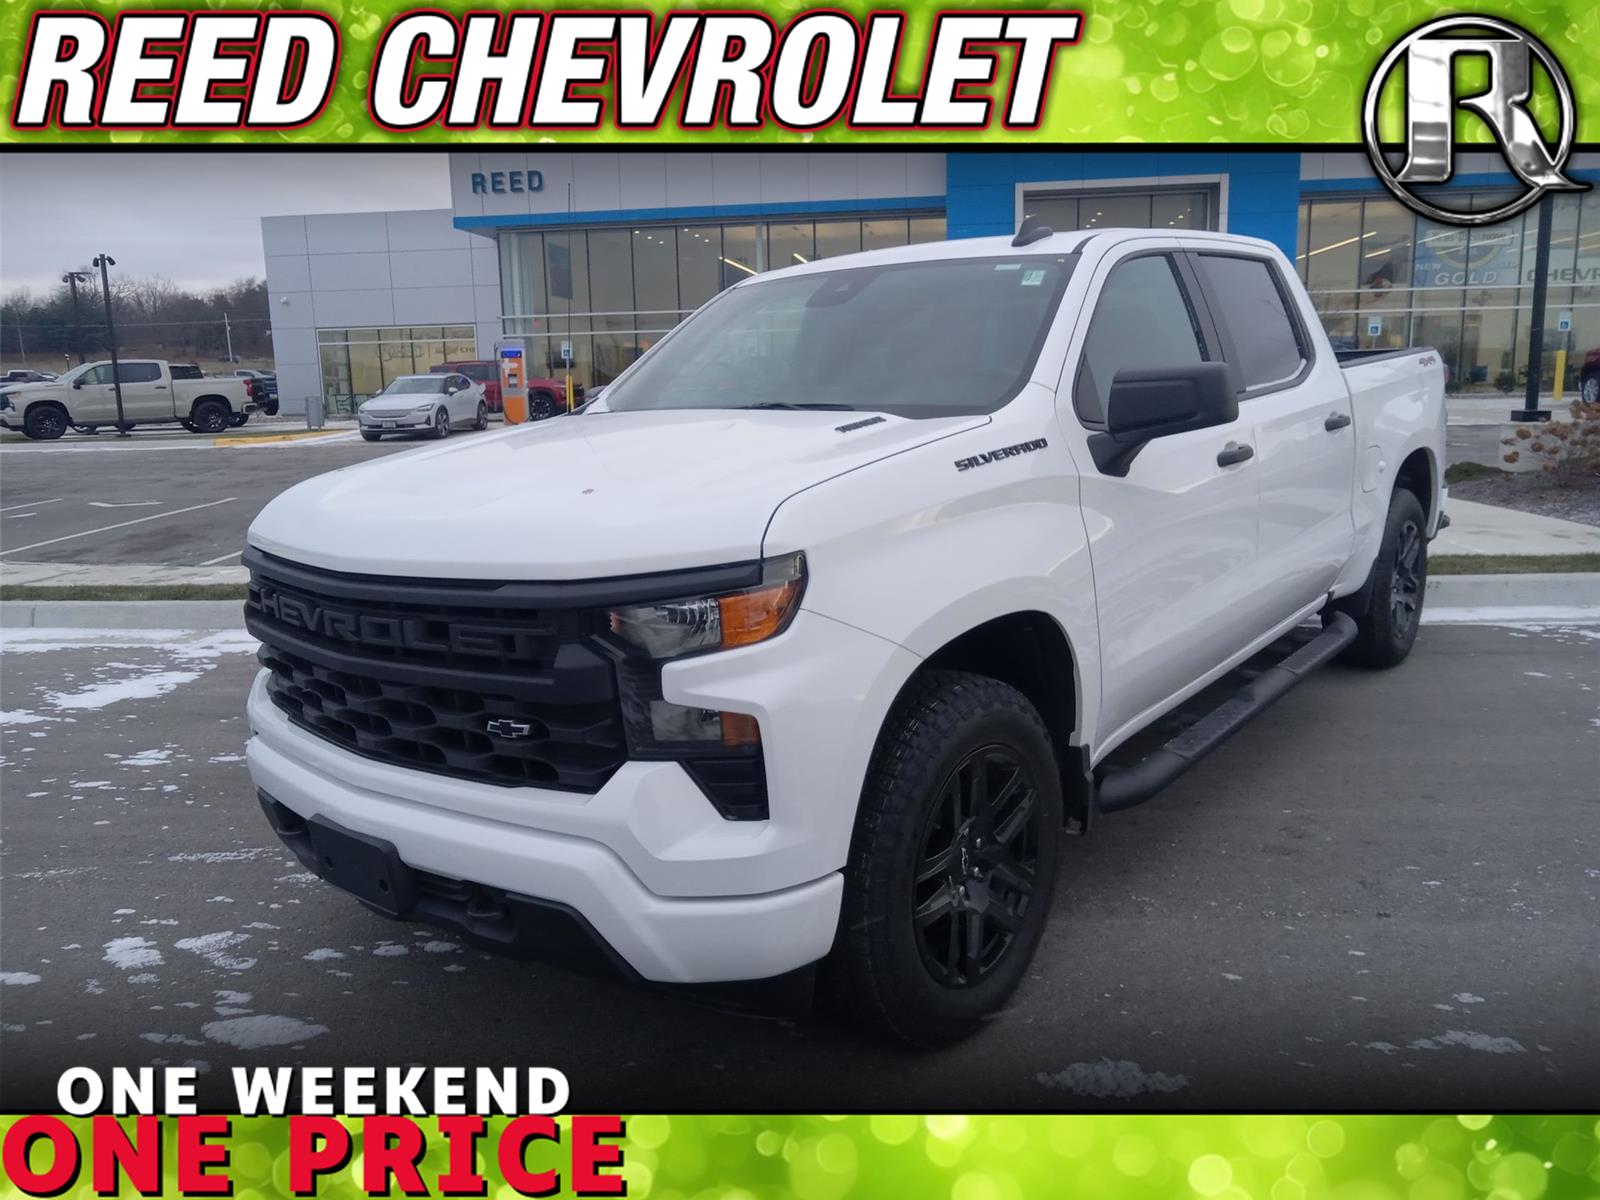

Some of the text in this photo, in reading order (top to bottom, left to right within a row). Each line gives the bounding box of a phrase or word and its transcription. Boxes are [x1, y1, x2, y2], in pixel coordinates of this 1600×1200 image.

[472, 170, 543, 194] REED
[1434, 271, 1498, 286] GOLD
[953, 437, 1048, 472] SILVERADO
[248, 582, 554, 659] CHEVROLET
